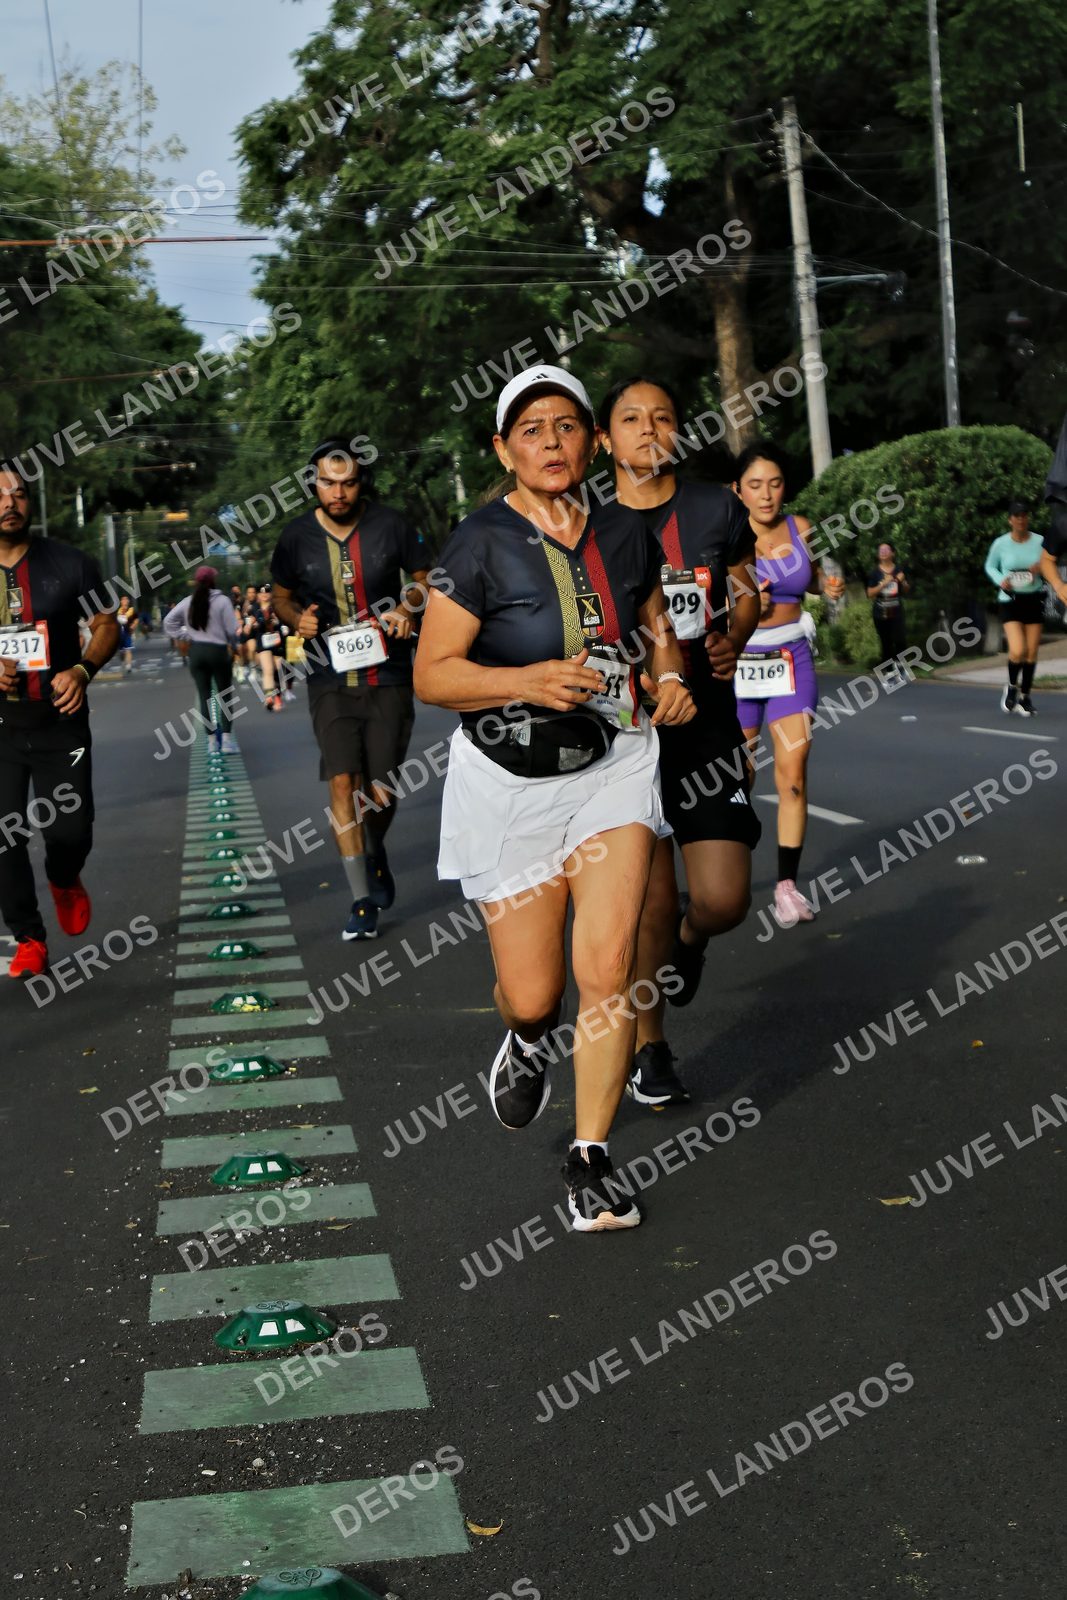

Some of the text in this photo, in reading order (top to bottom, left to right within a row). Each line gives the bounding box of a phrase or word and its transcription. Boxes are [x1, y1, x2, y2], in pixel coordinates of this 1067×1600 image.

[1, 637, 40, 655] 2317
[337, 634, 373, 654] 8669
[739, 663, 785, 680] 12169
